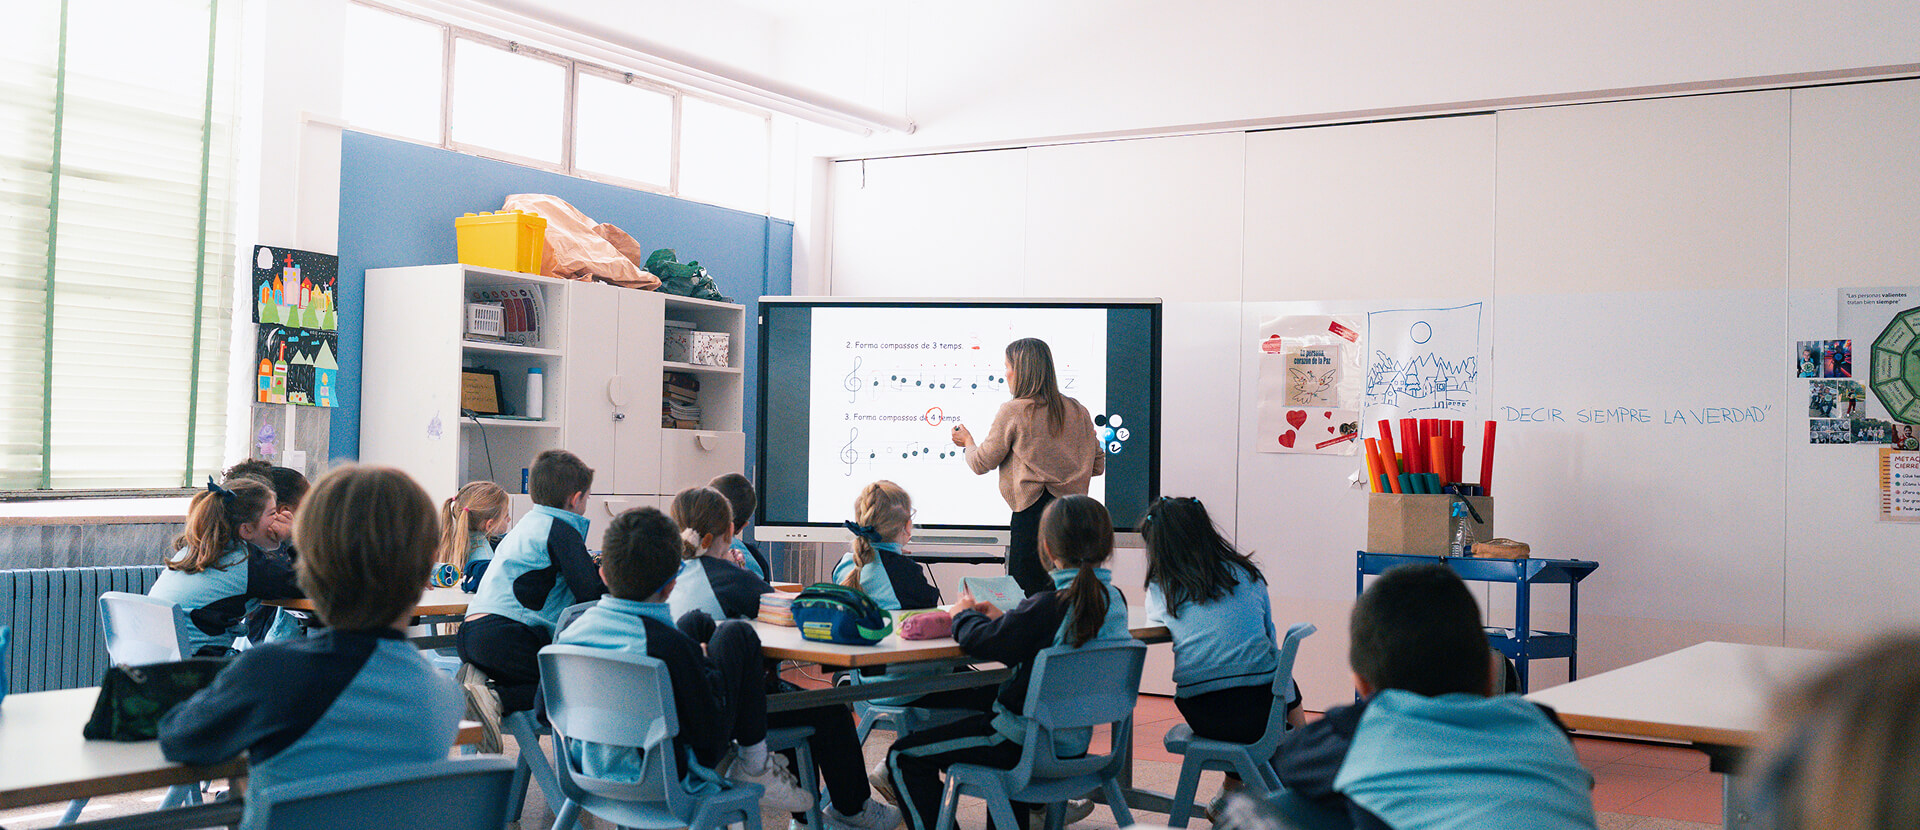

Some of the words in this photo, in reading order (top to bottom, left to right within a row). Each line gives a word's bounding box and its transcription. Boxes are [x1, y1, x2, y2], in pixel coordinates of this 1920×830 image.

[846, 341, 853, 349] 2.
[854, 341, 879, 349] Forma
[880, 342, 919, 351] compassos
[920, 341, 930, 349] de
[932, 341, 937, 349] 3
[939, 342, 964, 351] temps.
[853, 413, 877, 421] Forma
[879, 414, 918, 422] compassos
[919, 413, 929, 421] de
[1576, 406, 1651, 424] SIEMPRE
[1664, 409, 1687, 425] LA
